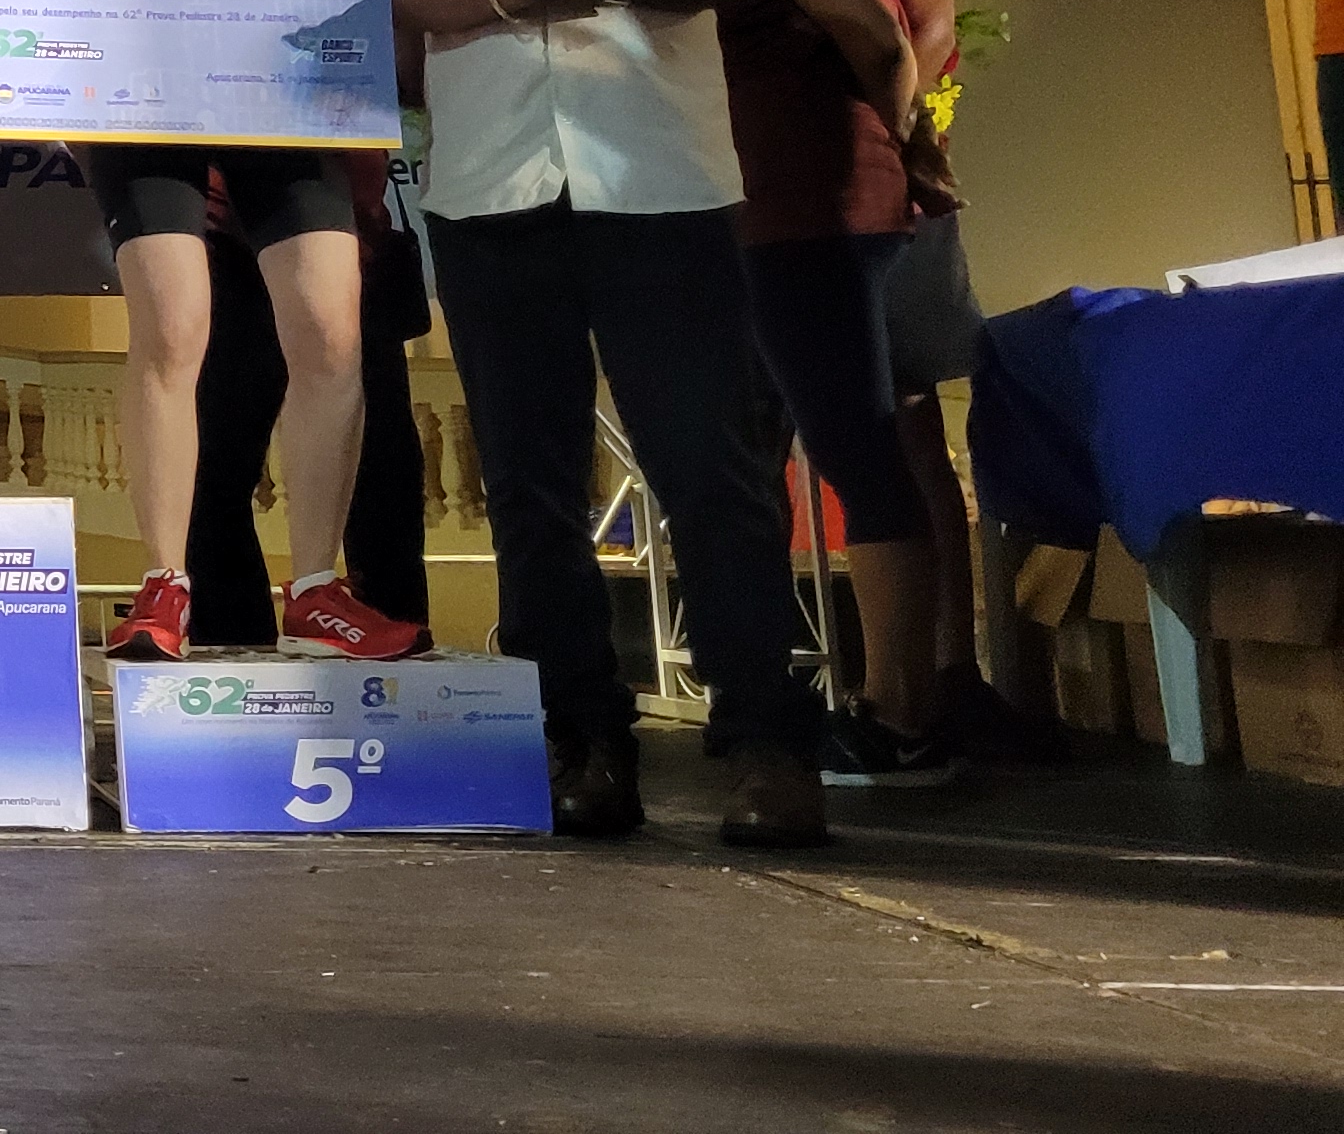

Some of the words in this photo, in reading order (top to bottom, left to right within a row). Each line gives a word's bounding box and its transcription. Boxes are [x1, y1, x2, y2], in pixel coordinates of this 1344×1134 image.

[22, 8, 38, 16] seu
[42, 7, 101, 19] desempenho
[58, 50, 102, 59] JANEIRO
[361, 676, 400, 707] 81
[244, 703, 260, 714] 28
[273, 702, 332, 714] JANEIRO
[483, 713, 534, 721] SANEPAR
[283, 738, 385, 823] 5º
